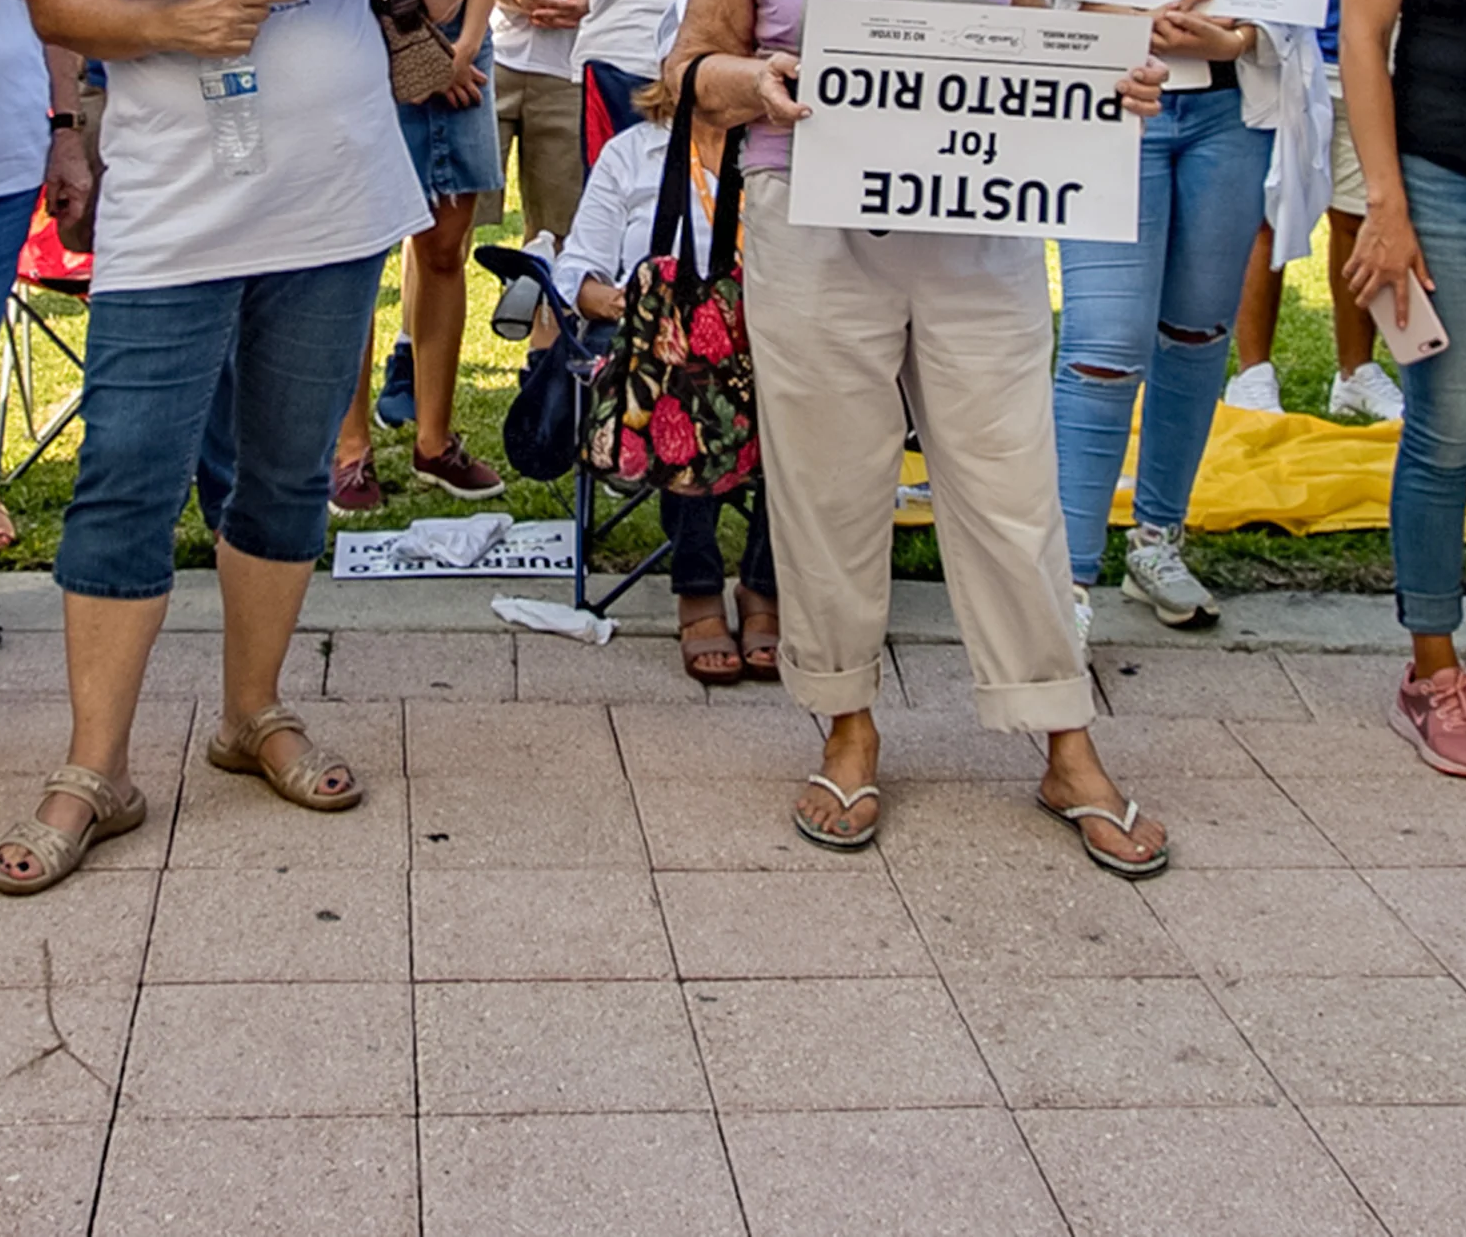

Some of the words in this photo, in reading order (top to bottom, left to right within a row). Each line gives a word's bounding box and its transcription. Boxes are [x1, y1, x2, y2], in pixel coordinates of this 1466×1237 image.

[818, 66, 925, 111] RICO
[937, 74, 1124, 122] PUERTO
[938, 130, 998, 165] for
[861, 171, 1085, 225] JUSTICE
